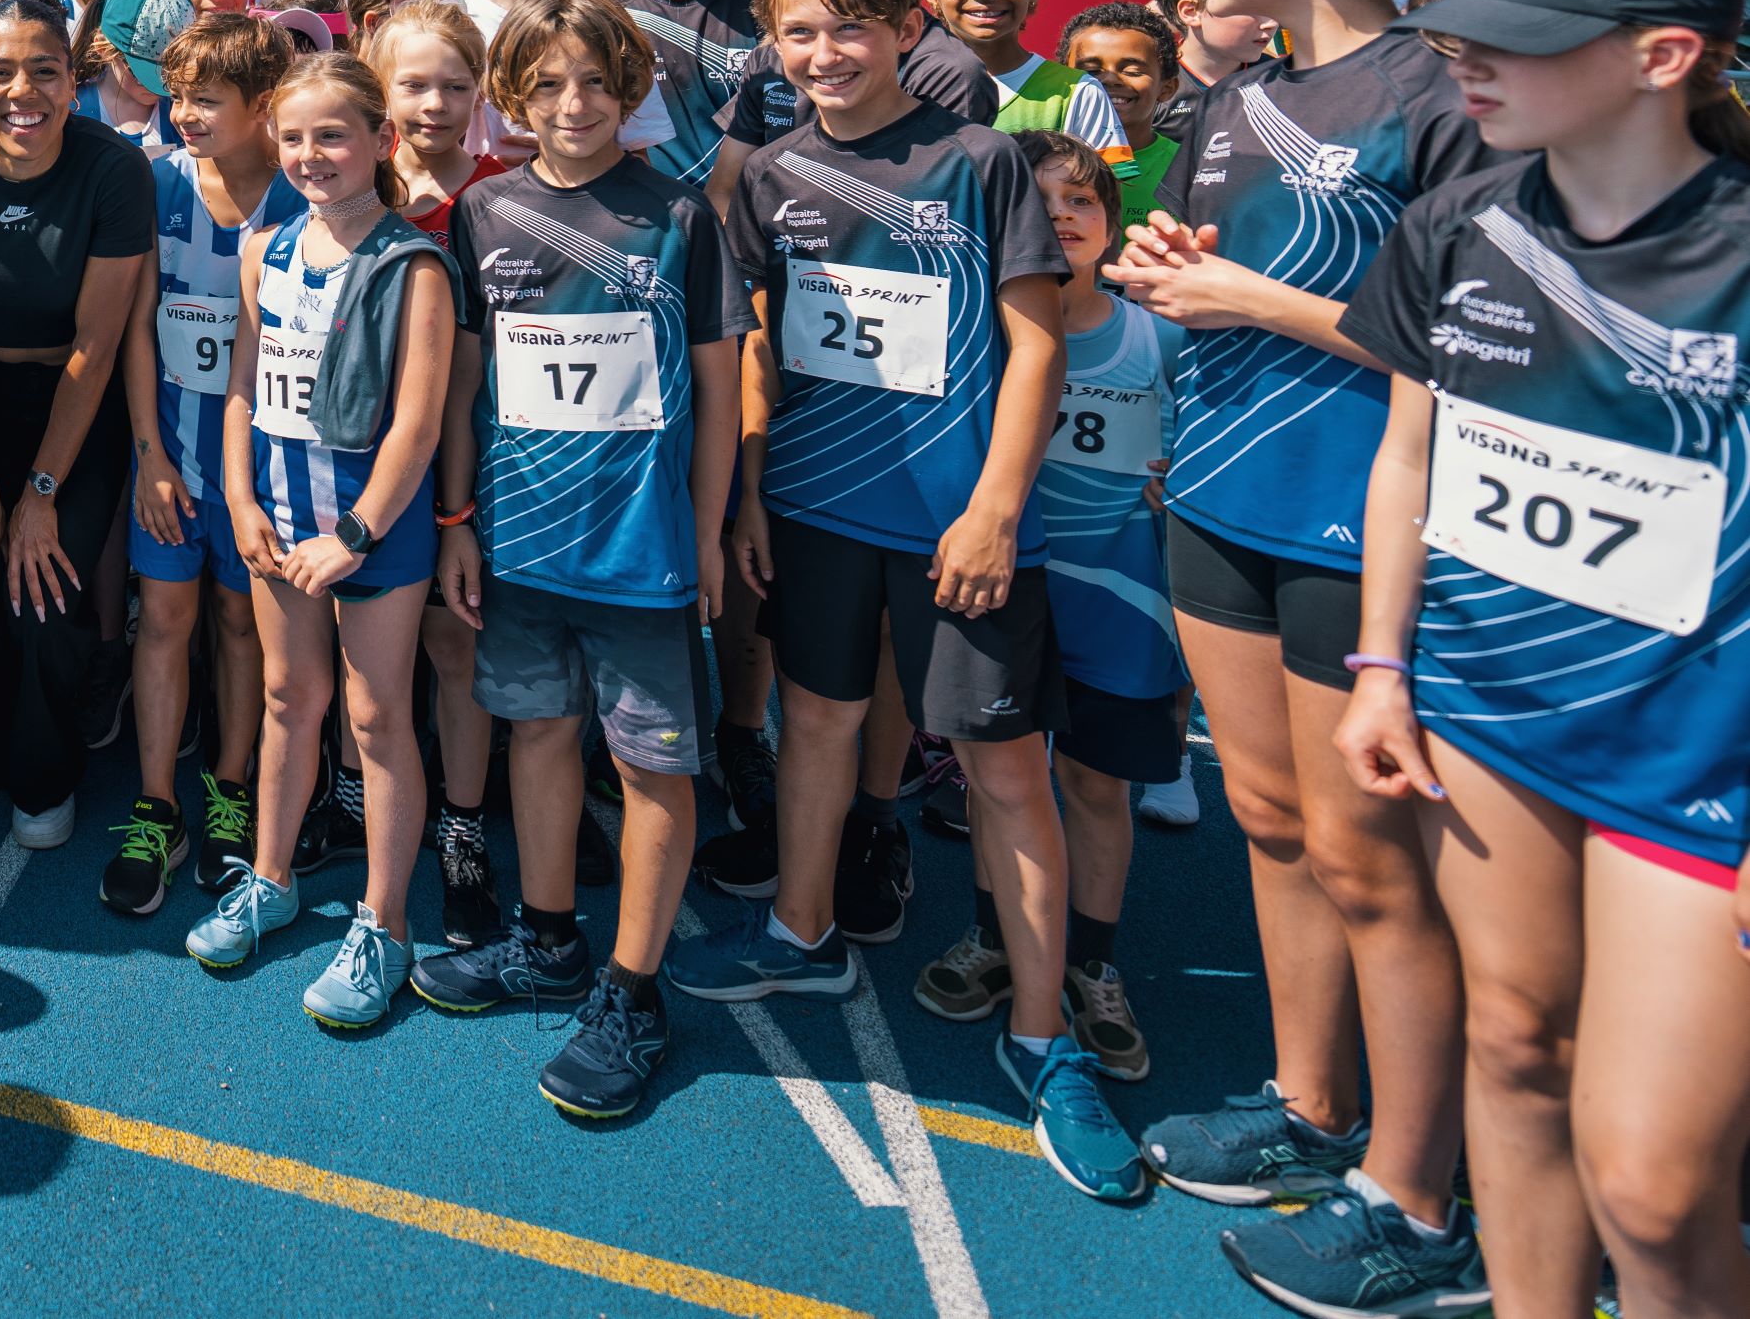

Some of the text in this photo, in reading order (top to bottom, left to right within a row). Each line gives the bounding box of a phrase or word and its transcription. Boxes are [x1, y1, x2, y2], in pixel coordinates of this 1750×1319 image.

[5, 205, 29, 216] NIKE
[785, 209, 821, 219] Retraites
[1126, 207, 1143, 216] FSG
[787, 217, 827, 227] Populaires
[794, 236, 829, 250] Sogetri
[890, 232, 969, 242] CARIVIERA
[494, 259, 534, 267] Retraites
[494, 267, 542, 277] Populaires
[502, 286, 544, 300] Sogetri
[854, 287, 932, 306] SPRINT
[568, 331, 639, 346] SPRINT
[820, 310, 884, 360] 25
[287, 348, 322, 361] SPRI
[543, 362, 598, 406] 17
[264, 372, 316, 416] 113
[1074, 386, 1148, 405] SPRINT
[1555, 460, 1692, 499] SPRINT
[1474, 473, 1642, 569] 207
